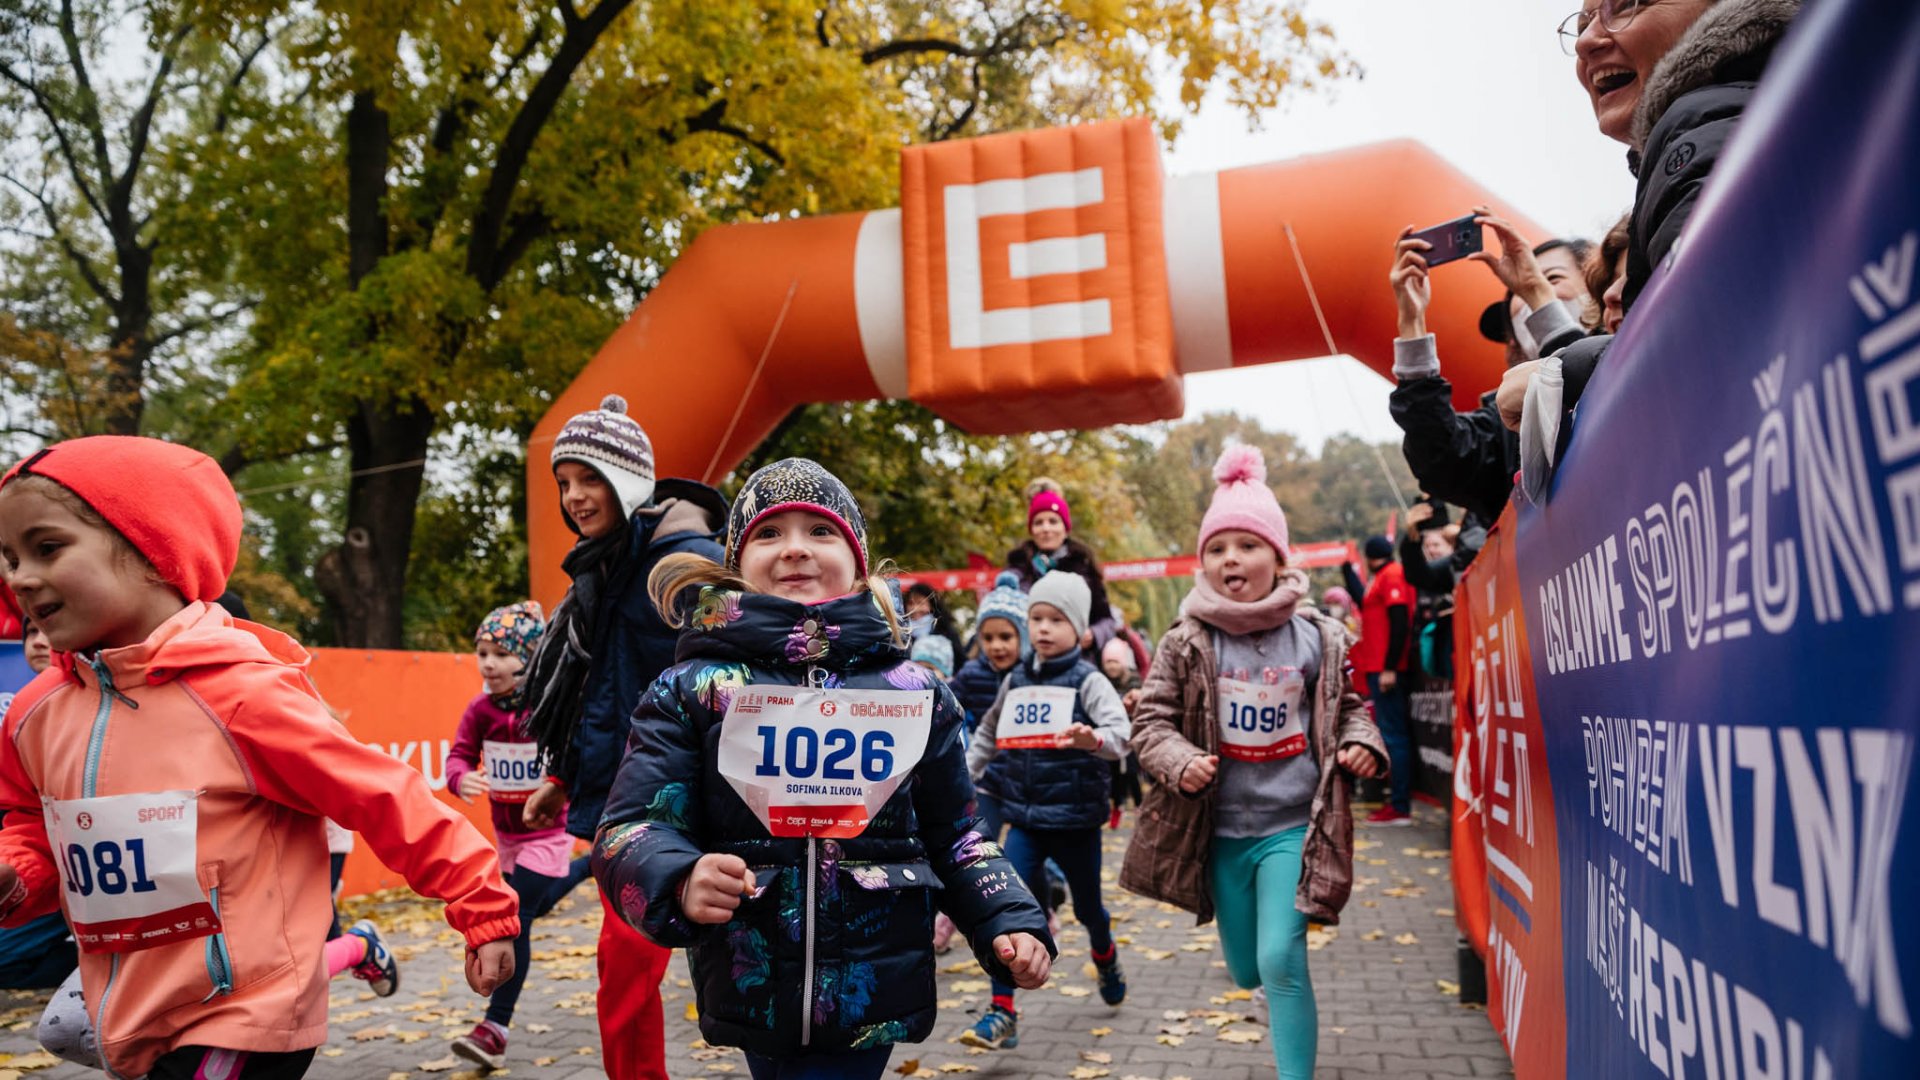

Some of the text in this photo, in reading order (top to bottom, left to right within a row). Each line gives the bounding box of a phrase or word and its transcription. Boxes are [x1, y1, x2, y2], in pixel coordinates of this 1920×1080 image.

[1540, 535, 1632, 674] OSLAVME
[767, 696, 795, 705] PRAHA
[850, 701, 924, 717] OBČANSTVÍ
[1014, 703, 1051, 724] 382
[1228, 702, 1287, 733] 1096
[755, 726, 895, 781] 1026
[786, 784, 862, 796] SOFINKA ILKOVA
[1581, 715, 1693, 886] POHYBEM
[138, 805, 184, 823] SPORT
[982, 881, 1008, 899] PLAY
